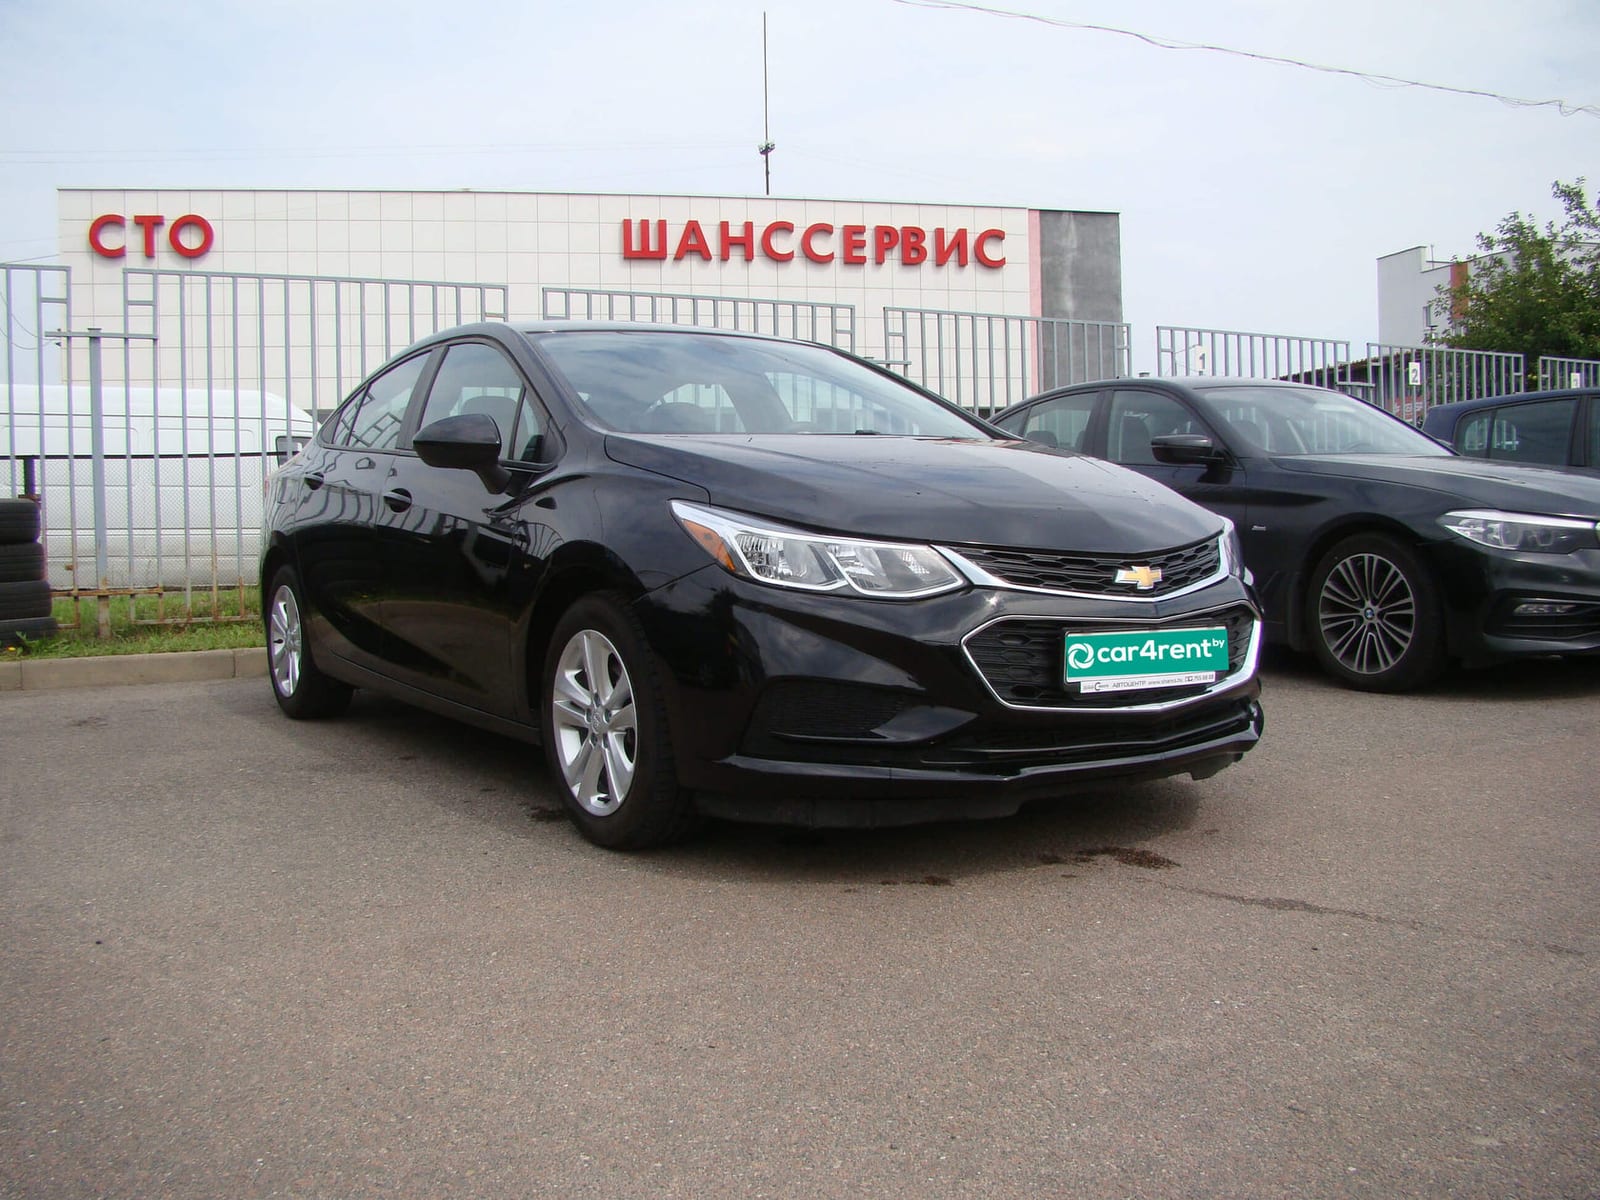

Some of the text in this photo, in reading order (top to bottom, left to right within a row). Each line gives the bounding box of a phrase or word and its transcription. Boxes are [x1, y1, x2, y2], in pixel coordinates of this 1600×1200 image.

[88, 213, 215, 259] СТО
[622, 218, 1007, 269] ШАНССЕРВИС
[1199, 353, 1205, 369] 1
[1411, 369, 1418, 383] 2
[1097, 639, 1212, 663] car4rent
